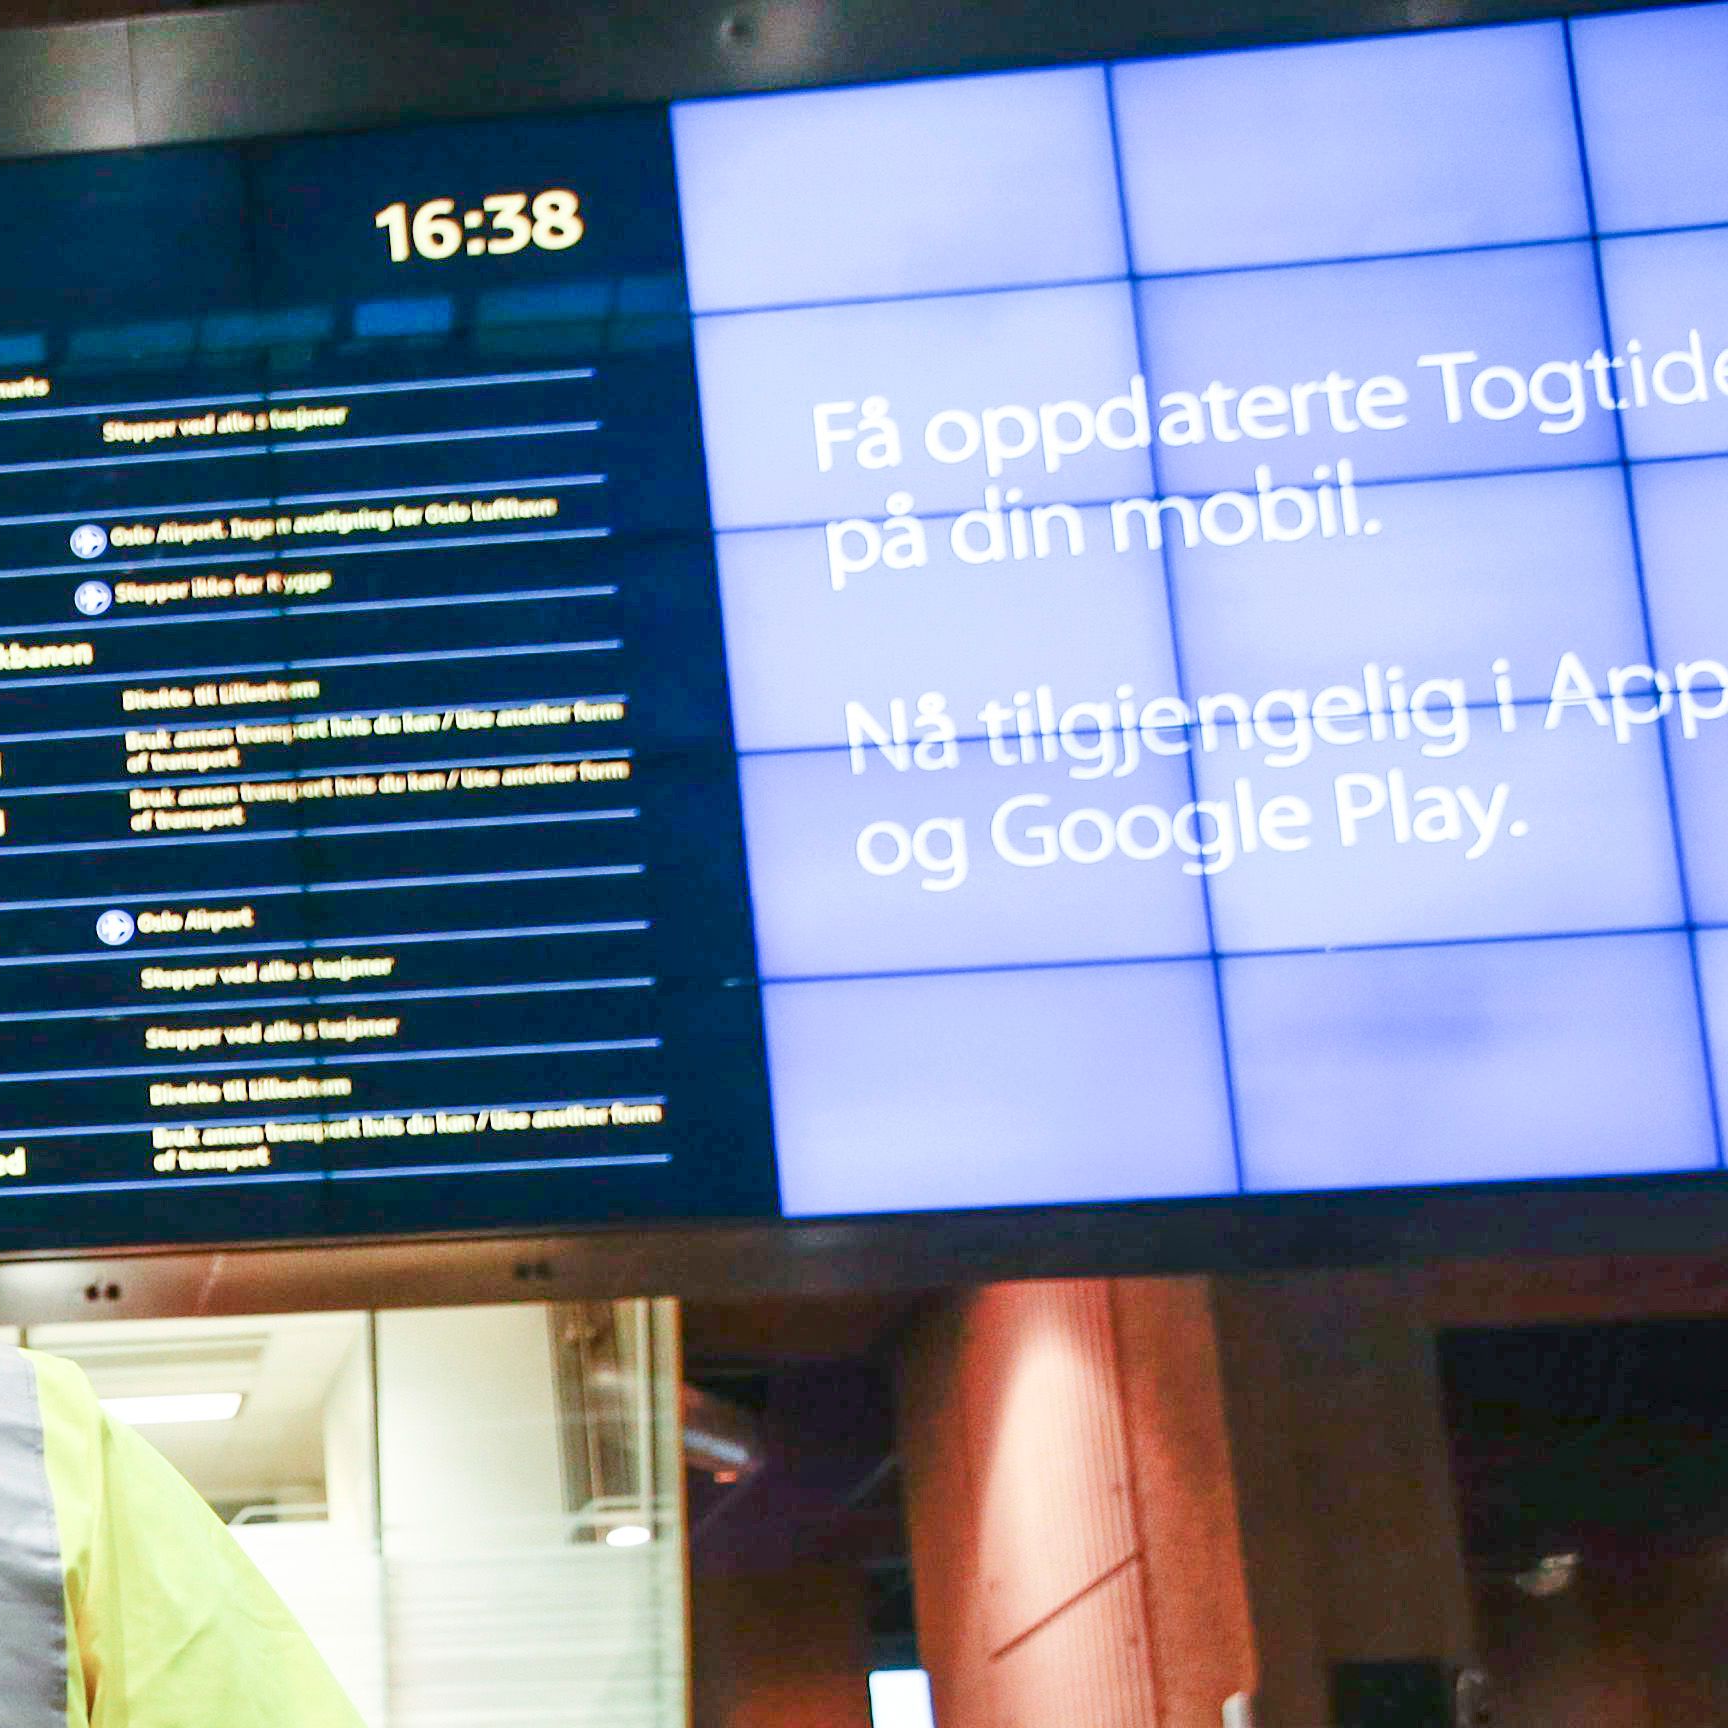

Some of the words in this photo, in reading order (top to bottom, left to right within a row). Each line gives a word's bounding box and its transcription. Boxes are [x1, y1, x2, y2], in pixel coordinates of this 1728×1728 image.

[375, 189, 585, 262] 16:38
[813, 395, 902, 473] Få
[922, 371, 1410, 477] oppdaterte
[826, 490, 929, 592] på
[950, 483, 1087, 565] din
[1111, 458, 1384, 554] mobil.
[844, 689, 960, 775] Nå
[978, 663, 1470, 783] tilgjengelig
[1491, 656, 1520, 736] i
[856, 817, 969, 892] og
[990, 776, 1315, 876] Google
[1334, 768, 1528, 860] Play.
